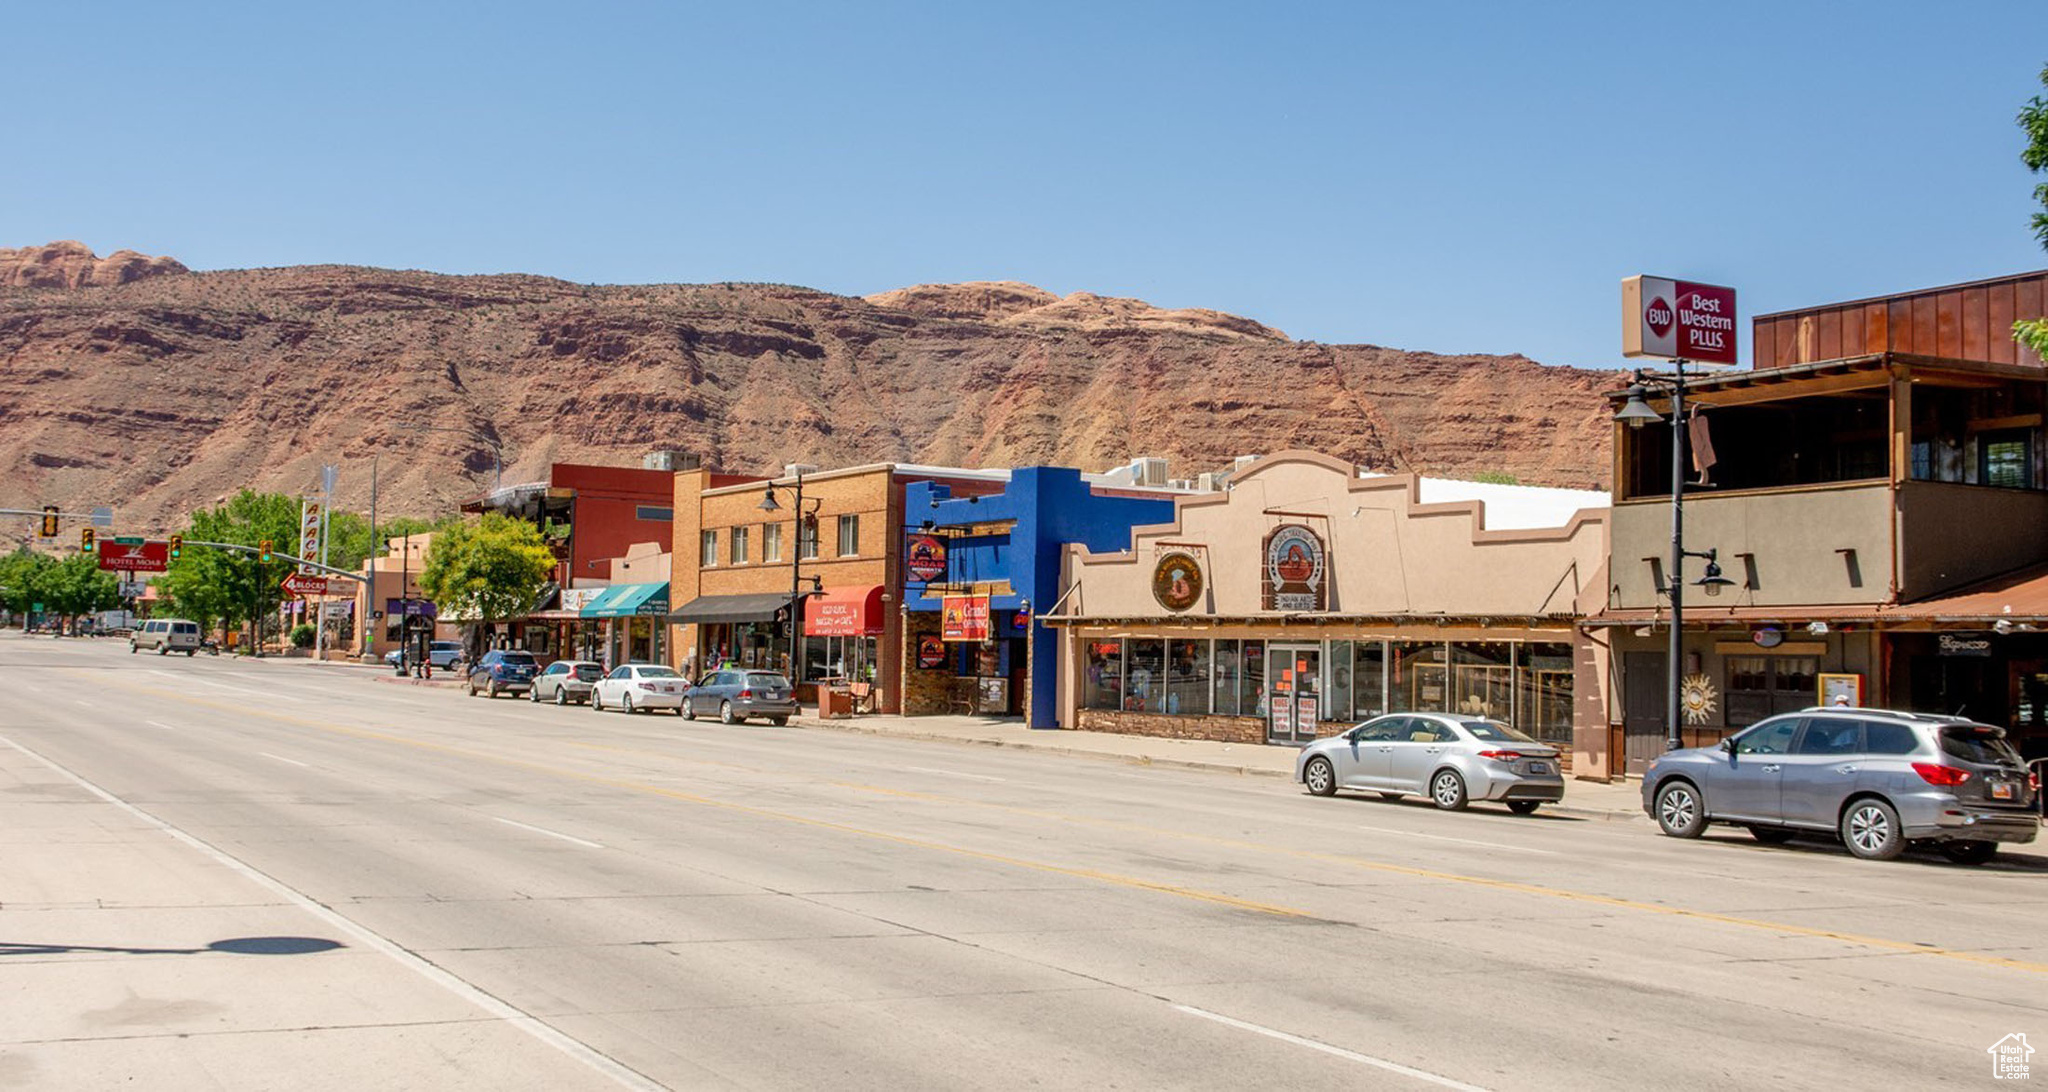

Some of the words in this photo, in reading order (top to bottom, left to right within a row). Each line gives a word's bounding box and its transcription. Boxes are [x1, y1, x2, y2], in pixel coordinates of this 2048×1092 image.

[1692, 294, 1720, 313] Best
[1649, 308, 1671, 325] BW
[1680, 309, 1732, 330] Western
[1690, 328, 1724, 347] PLUS
[302, 504, 319, 574] APACHE
[106, 557, 135, 565] HOTEL
[136, 558, 162, 566] MOAB
[909, 560, 946, 569] MOAB
[286, 579, 296, 590] 4
[296, 581, 327, 590] BLOCKS
[963, 603, 987, 617] Grand
